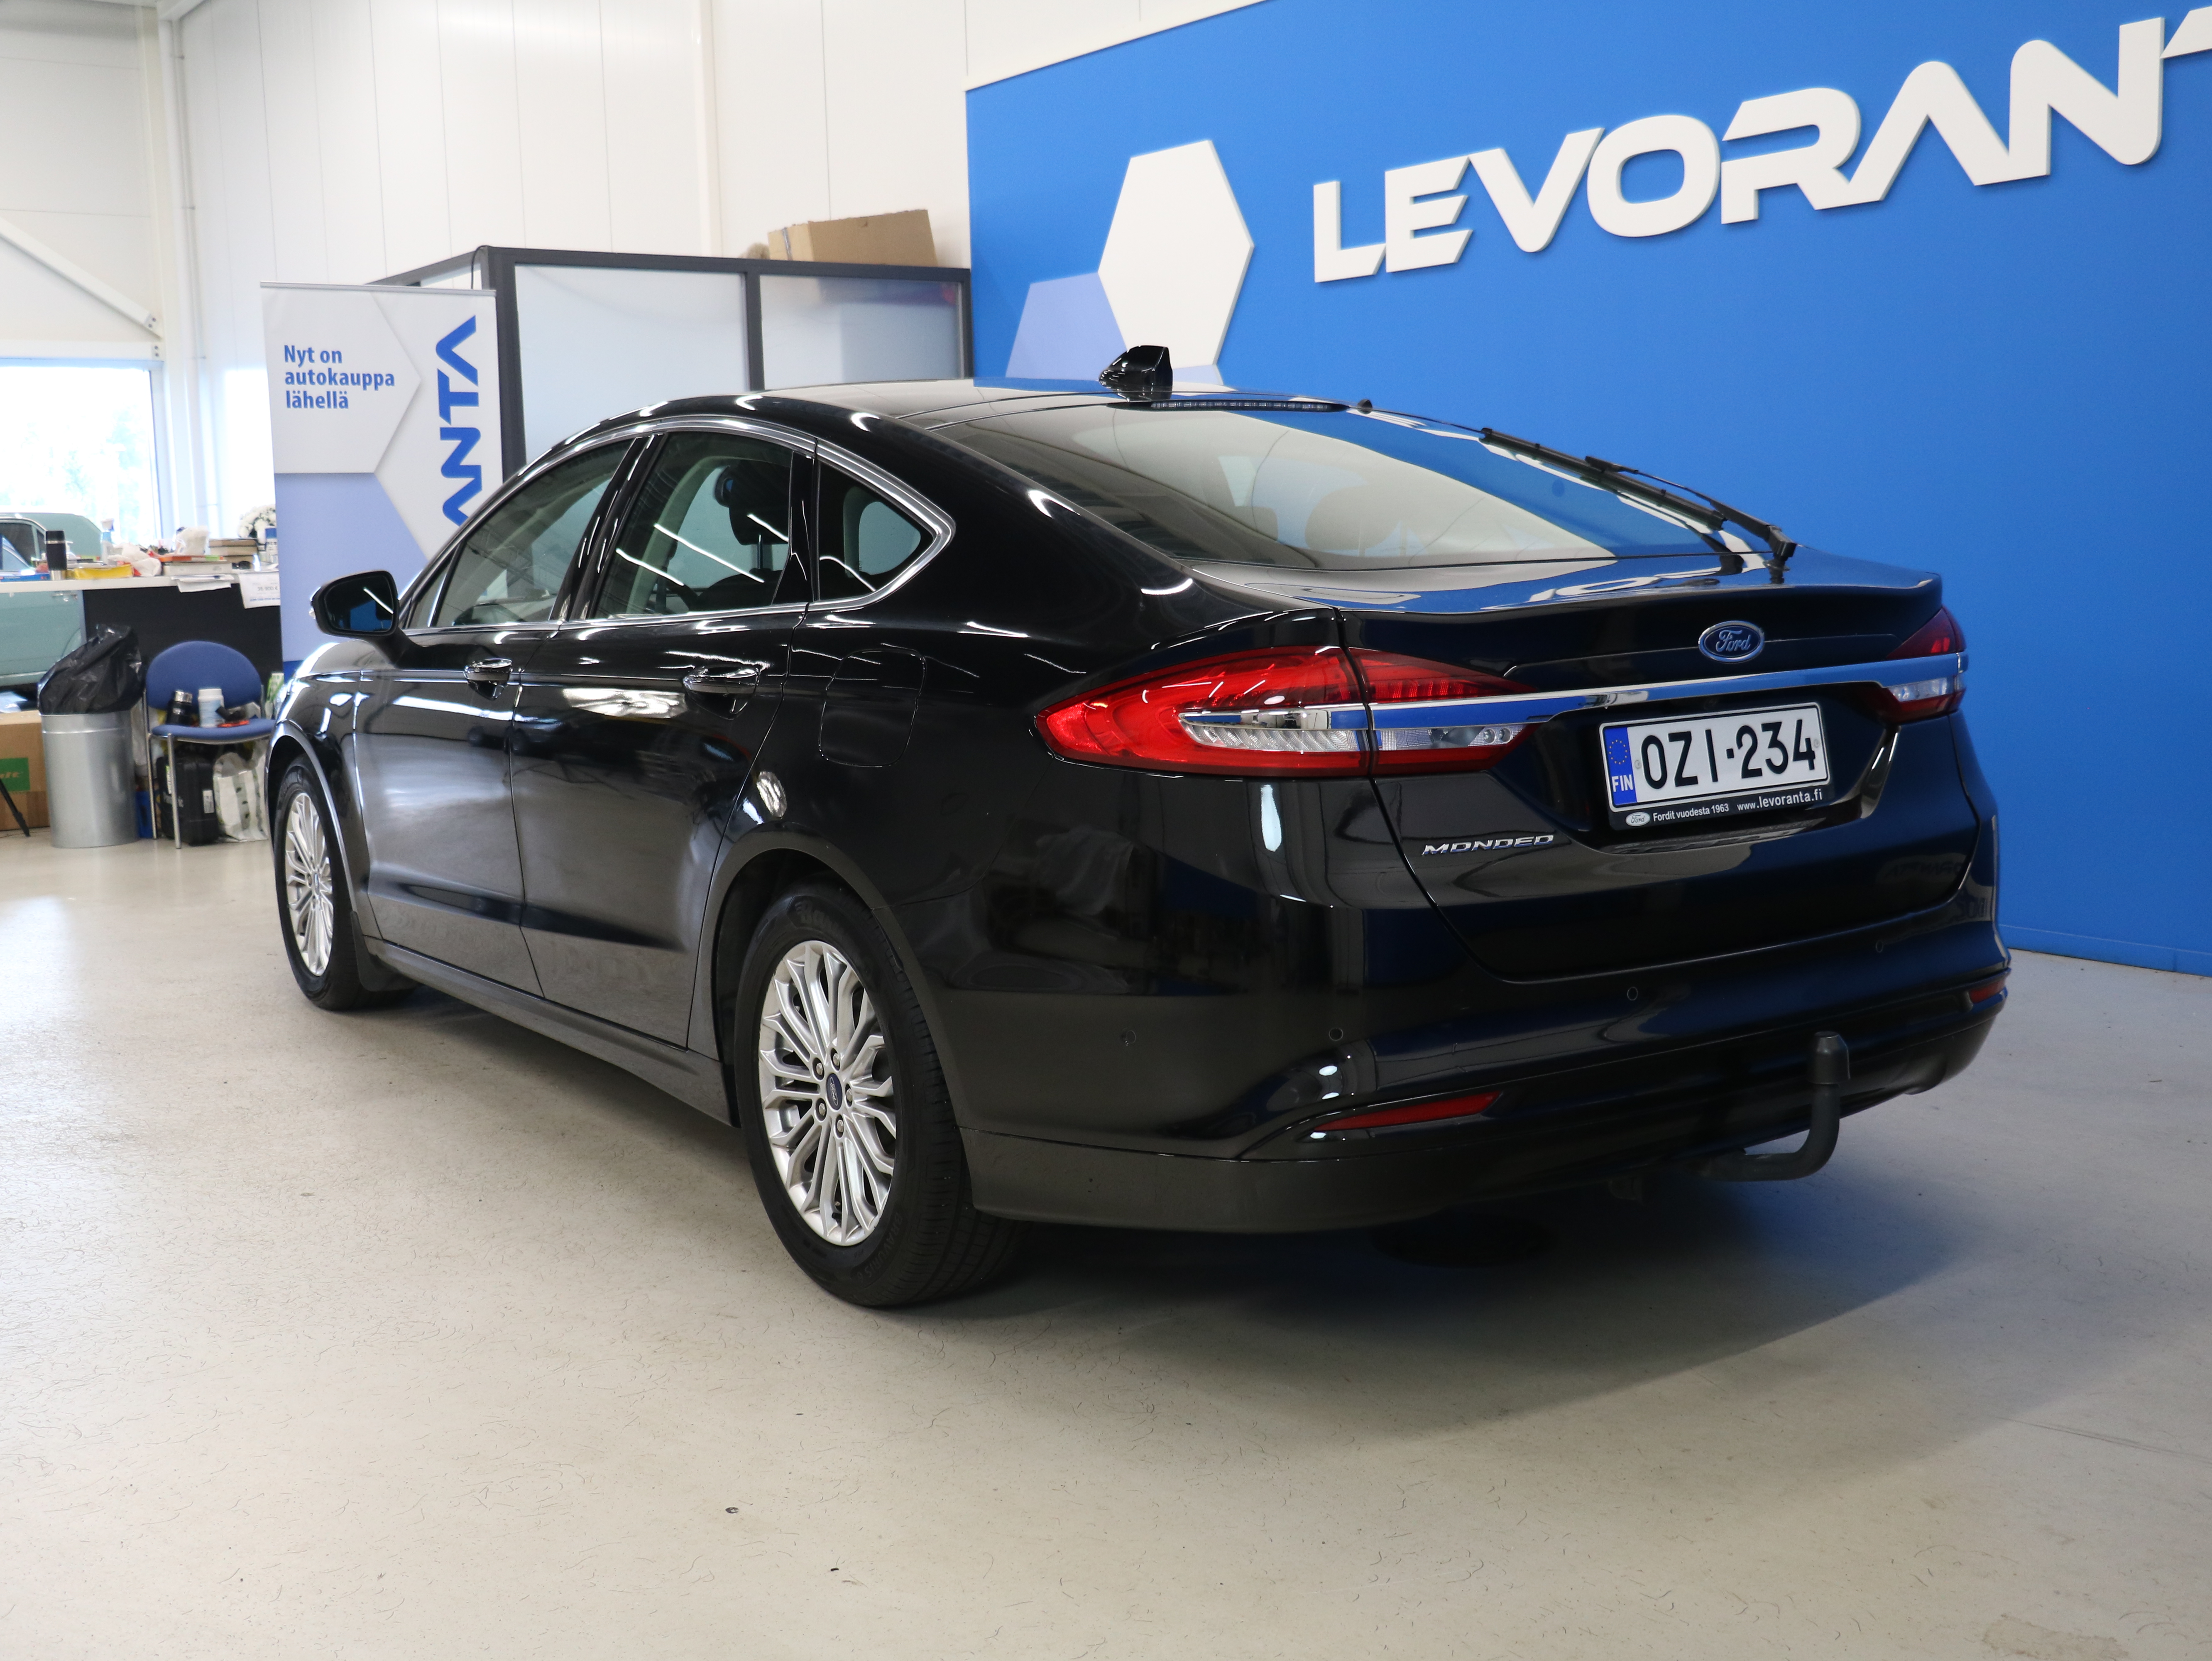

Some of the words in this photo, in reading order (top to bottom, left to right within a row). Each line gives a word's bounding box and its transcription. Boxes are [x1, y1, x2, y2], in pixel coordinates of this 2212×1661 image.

[284, 345, 315, 368] Nyt
[320, 350, 342, 363] on
[285, 367, 394, 391] autokauppa
[286, 390, 348, 409] lähellä
[1715, 630, 1752, 652] Ford
[1641, 719, 1816, 789] OZI-234
[1611, 774, 1633, 792] FIN
[1737, 789, 1822, 811] www.levoranta.fi
[1631, 815, 1644, 823] Ford
[1653, 811, 1675, 821] Fordit
[1676, 807, 1710, 818] vuodesta
[1711, 804, 1729, 813] 1963
[1422, 835, 1554, 856] MONDEO
[864, 1212, 903, 1278] BRAVURIS
